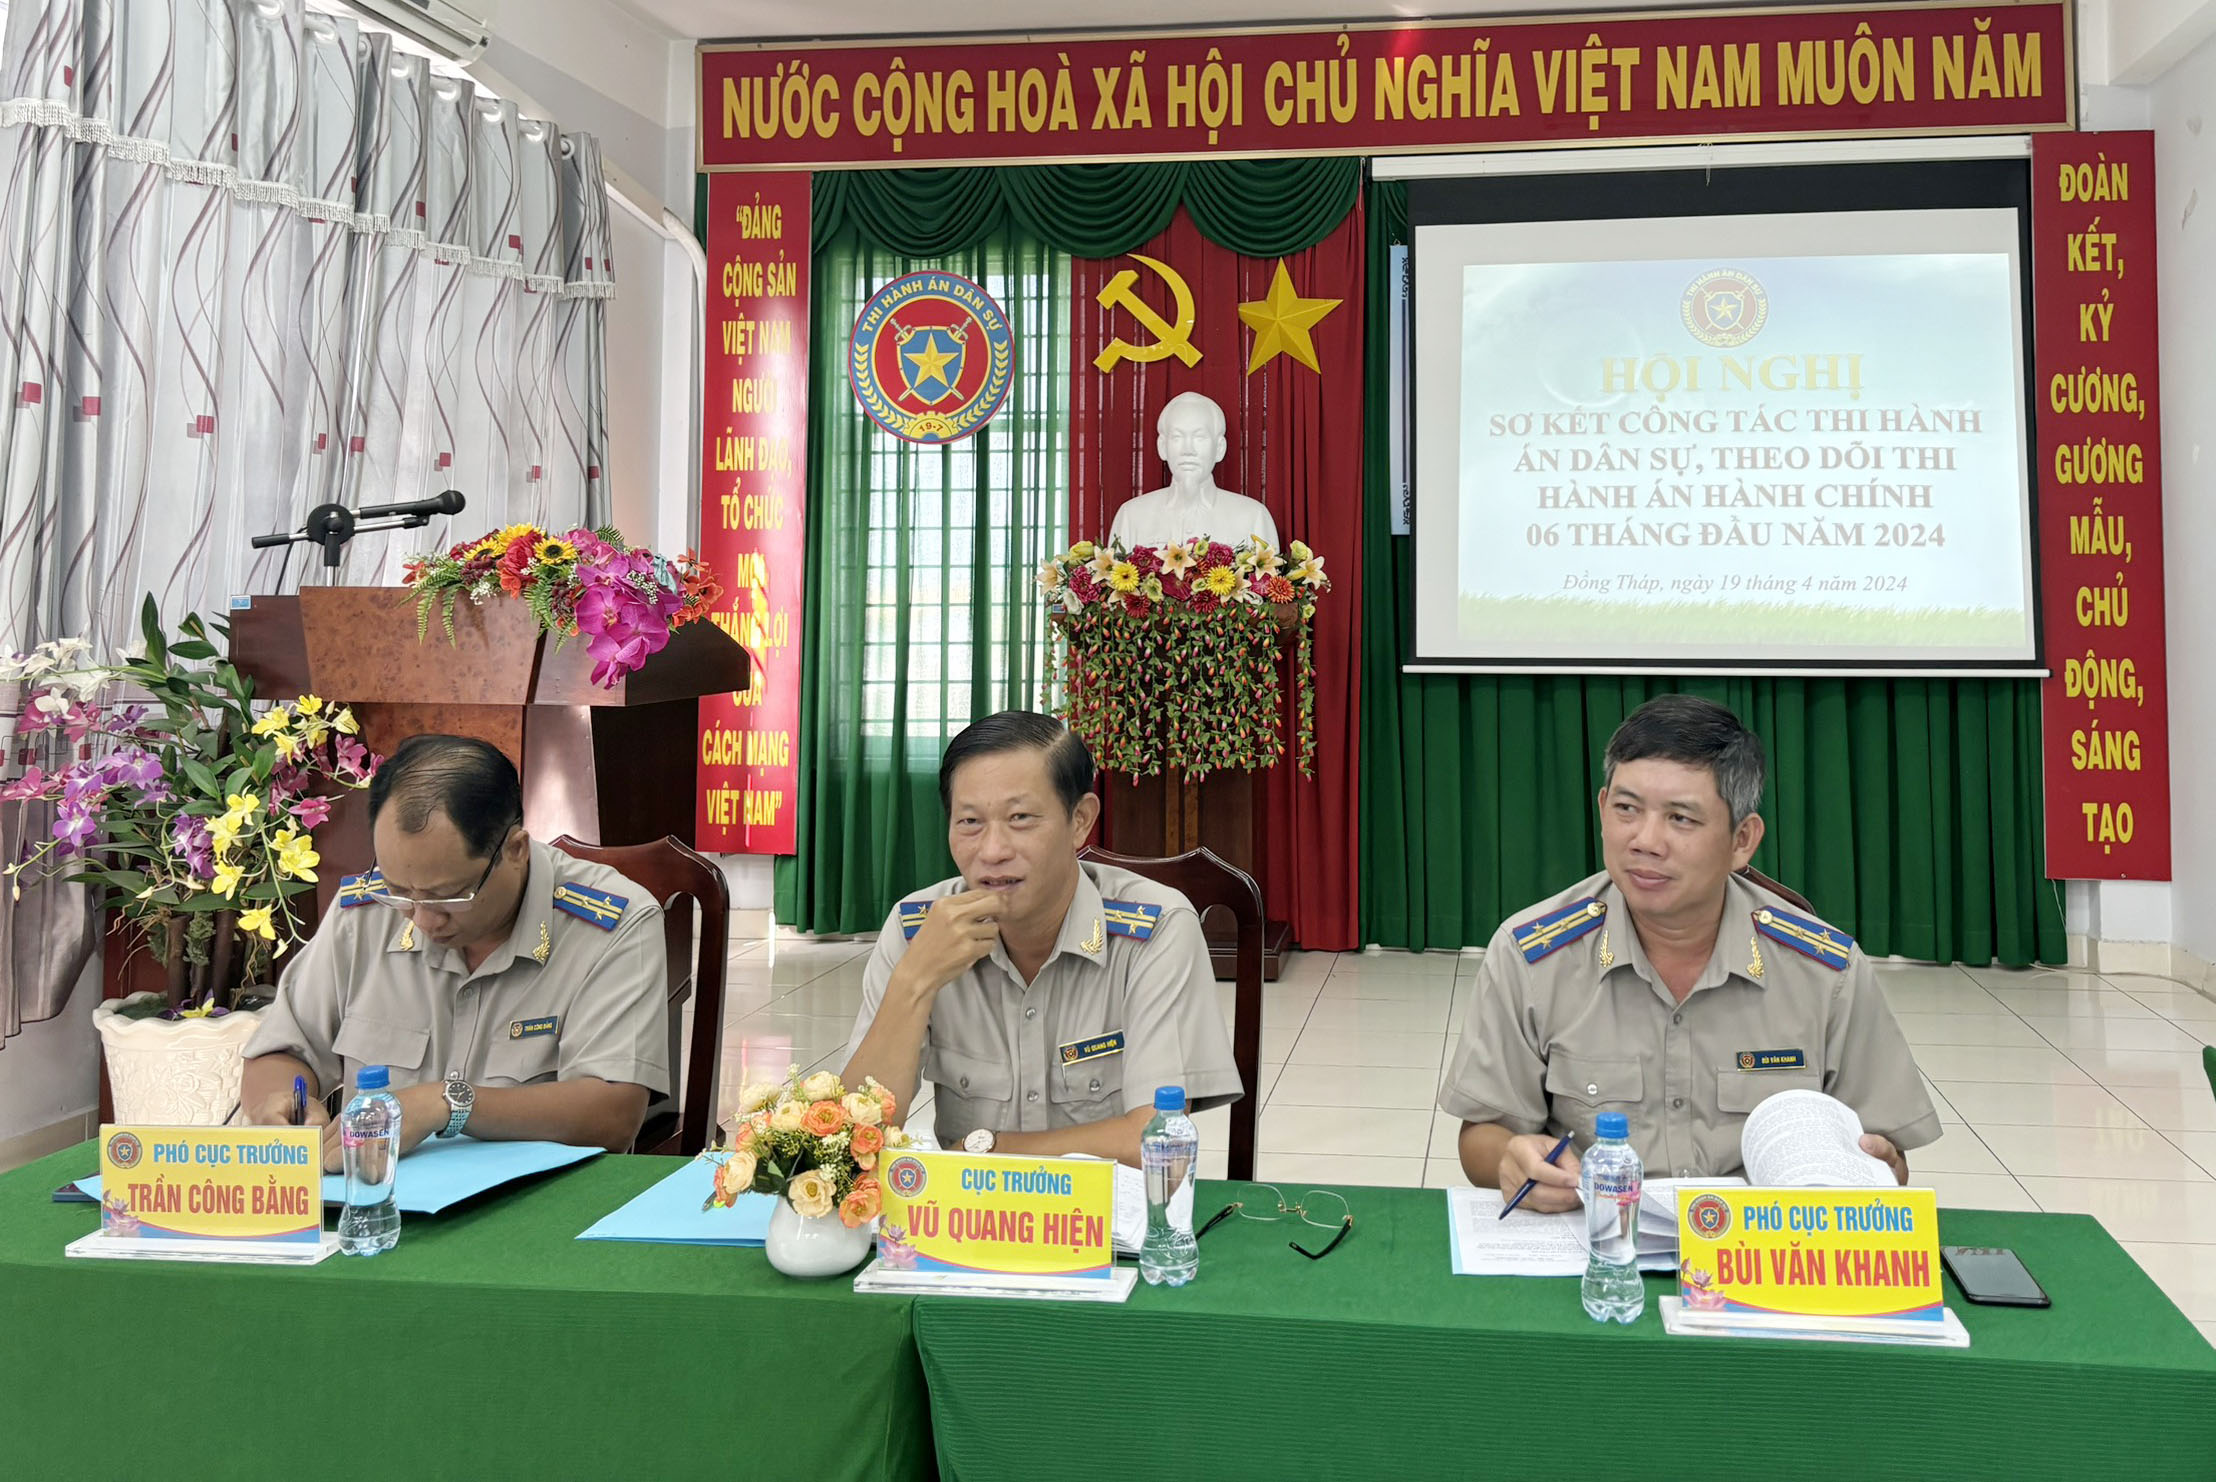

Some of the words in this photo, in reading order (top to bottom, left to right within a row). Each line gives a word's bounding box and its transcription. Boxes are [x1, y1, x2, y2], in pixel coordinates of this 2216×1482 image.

[722, 60, 841, 139] NƯỚC
[852, 56, 975, 152] CỘNG
[987, 52, 1078, 132] HOÀ
[1091, 50, 1152, 129] XÃ
[1167, 47, 1243, 144] HỘI
[1264, 34, 1357, 126] CHỦ
[1374, 37, 1520, 121] NGHĨA
[1532, 33, 1640, 130] VIỆT
[1655, 42, 1761, 111] NAM
[1776, 22, 1915, 107] MUÔN
[1932, 16, 2042, 100] NĂM
[2059, 152, 2128, 202] ĐOÀN
[2067, 216, 2125, 280] KẾT,
[722, 255, 764, 307] CỘNG
[767, 249, 797, 298] SẢN
[862, 306, 884, 333] THI
[881, 279, 923, 308] HÀNH
[928, 276, 950, 292] ÁN
[953, 284, 985, 309] DÂN
[983, 308, 1004, 332] SỰ
[2079, 287, 2114, 342] KỶ
[722, 313, 756, 365] VIỆT
[759, 320, 791, 355] NAM
[732, 371, 784, 413] NGƯỜ
[1600, 352, 1704, 403] HỘI
[1719, 353, 1865, 401] NGHỊ
[2050, 366, 2145, 421] CƯƠNG,
[1489, 411, 1534, 437] SƠ
[1541, 405, 1610, 436] KẾT
[1618, 405, 1719, 434] CÔNG
[1726, 403, 1798, 433] TÁC
[1806, 408, 1871, 432] THI
[1878, 402, 1983, 433] HÀNH
[716, 426, 754, 471] LÃNH
[1513, 443, 1559, 472] ÁN
[1569, 442, 1641, 472] DÂN
[1650, 444, 1704, 476] SỰ,
[1711, 446, 1810, 470] THEO
[1818, 440, 1885, 470] DÕI
[1892, 446, 1958, 471] THI
[2055, 436, 2143, 484] GƯƠNG
[721, 477, 741, 530] TỔ
[744, 487, 784, 530] CHỨC
[1537, 479, 1638, 509] HÀNH
[1645, 478, 1694, 508] ÁN
[1702, 477, 1806, 508] HÀNH
[1814, 477, 1934, 508] CHÍNH
[1526, 522, 1560, 547] 06
[1567, 515, 1691, 546] THÁNG
[1698, 515, 1773, 546] ĐẦU
[1782, 516, 1866, 547] NĂM
[1873, 522, 1946, 547] 2024
[2069, 497, 2131, 563] MẪU,
[1563, 570, 1612, 594] Đồng
[1616, 574, 1664, 595] Tháp,
[1670, 574, 1714, 594] ngày
[1720, 574, 1741, 591] 19
[1746, 574, 1798, 595] tháng
[1802, 575, 1814, 591] 4
[1818, 575, 1857, 591] năm
[1863, 575, 1908, 592] 2024
[2076, 571, 2128, 627] CHỦ
[2064, 649, 2144, 710] ĐỘNG,
[702, 720, 742, 766] CÁCH
[747, 730, 789, 776] MẠNG
[2071, 719, 2141, 771] SÁNG
[706, 781, 740, 835] VIỆT
[2081, 802, 2134, 855] TẠO
[153, 1139, 189, 1164] PHÓ
[195, 1143, 231, 1168] CỤC
[236, 1137, 309, 1166] TRƯỞNG
[127, 1173, 181, 1214] TRẦN
[188, 1178, 245, 1215] CÔNG
[252, 1174, 309, 1216] BẰNG
[961, 1168, 996, 1197] CỤC
[1002, 1165, 1072, 1196] TRƯỞNG
[907, 1200, 940, 1238] VŨ
[948, 1207, 1034, 1244] QUANG
[1043, 1207, 1104, 1254] HIỆN
[1743, 1201, 1782, 1231] PHÓ
[1789, 1206, 1827, 1237] CỤC
[1835, 1197, 1913, 1232] TRƯỞNG
[1717, 1240, 1762, 1287] BÙI
[1771, 1241, 1827, 1287] VĂN
[1835, 1248, 1931, 1288] KHANH
